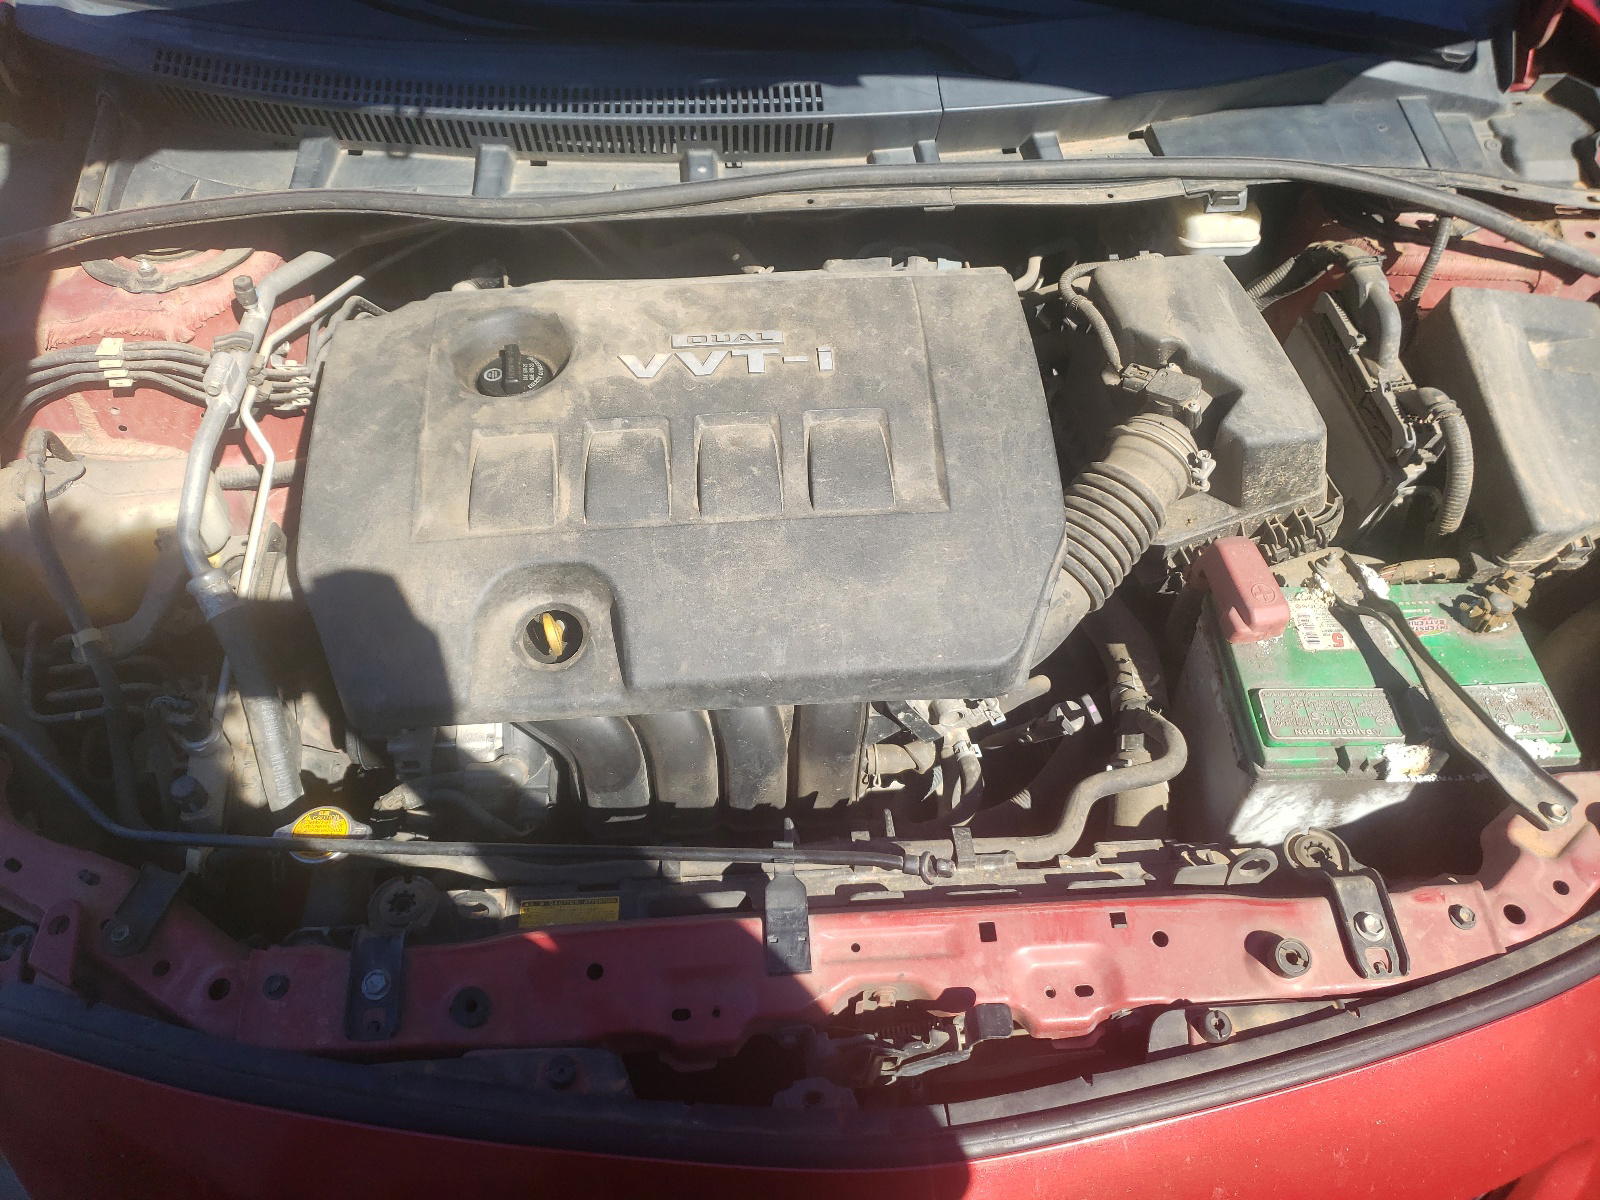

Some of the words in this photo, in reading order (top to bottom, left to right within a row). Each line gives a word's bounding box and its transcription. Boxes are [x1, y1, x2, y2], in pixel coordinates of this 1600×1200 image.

[686, 332, 774, 345] DUAL
[616, 347, 834, 379] VVT-i
[1331, 632, 1345, 648] 5
